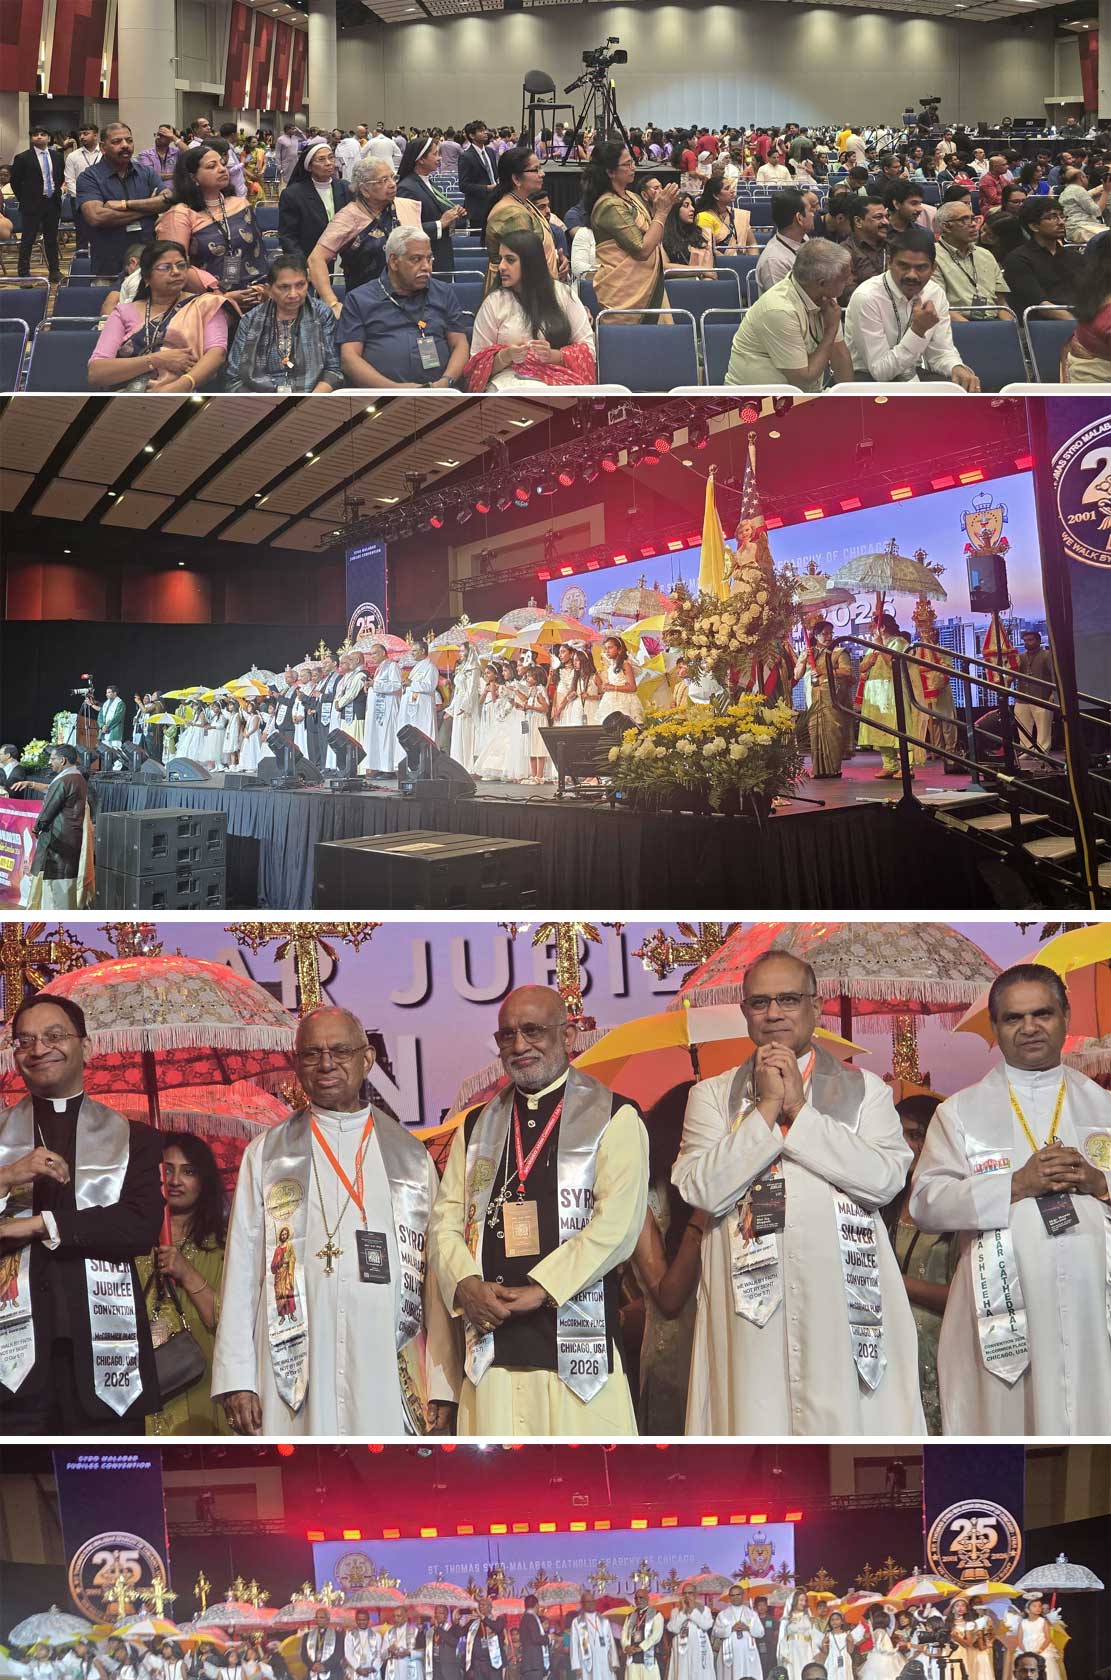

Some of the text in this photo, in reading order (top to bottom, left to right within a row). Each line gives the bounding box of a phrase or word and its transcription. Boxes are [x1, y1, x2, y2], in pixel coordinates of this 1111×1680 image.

[1064, 440, 1083, 460] SYRO
[1067, 511, 1096, 525] 2001
[1061, 531, 1073, 546] WE
[1073, 542, 1099, 562] WALK
[399, 1224, 425, 1252] SYRO
[841, 1223, 874, 1245] SILVER
[845, 1249, 876, 1269] JUBILEE
[93, 1281, 132, 1297] JUBILEE
[846, 1273, 879, 1288] CONVENTION
[978, 1254, 994, 1318] SHLEEHA
[998, 1260, 1018, 1332] CATHEDRAL
[93, 1304, 134, 1316] CONVENTION
[560, 1319, 590, 1328] McCORMICK
[858, 1342, 878, 1360] 2026
[986, 1347, 1028, 1362] CHICAGO, USA
[570, 1359, 599, 1376] 2026
[104, 1372, 130, 1387] 2026
[949, 1517, 999, 1552] 25
[92, 1549, 142, 1586] 25
[444, 1563, 480, 1574] THOMAS
